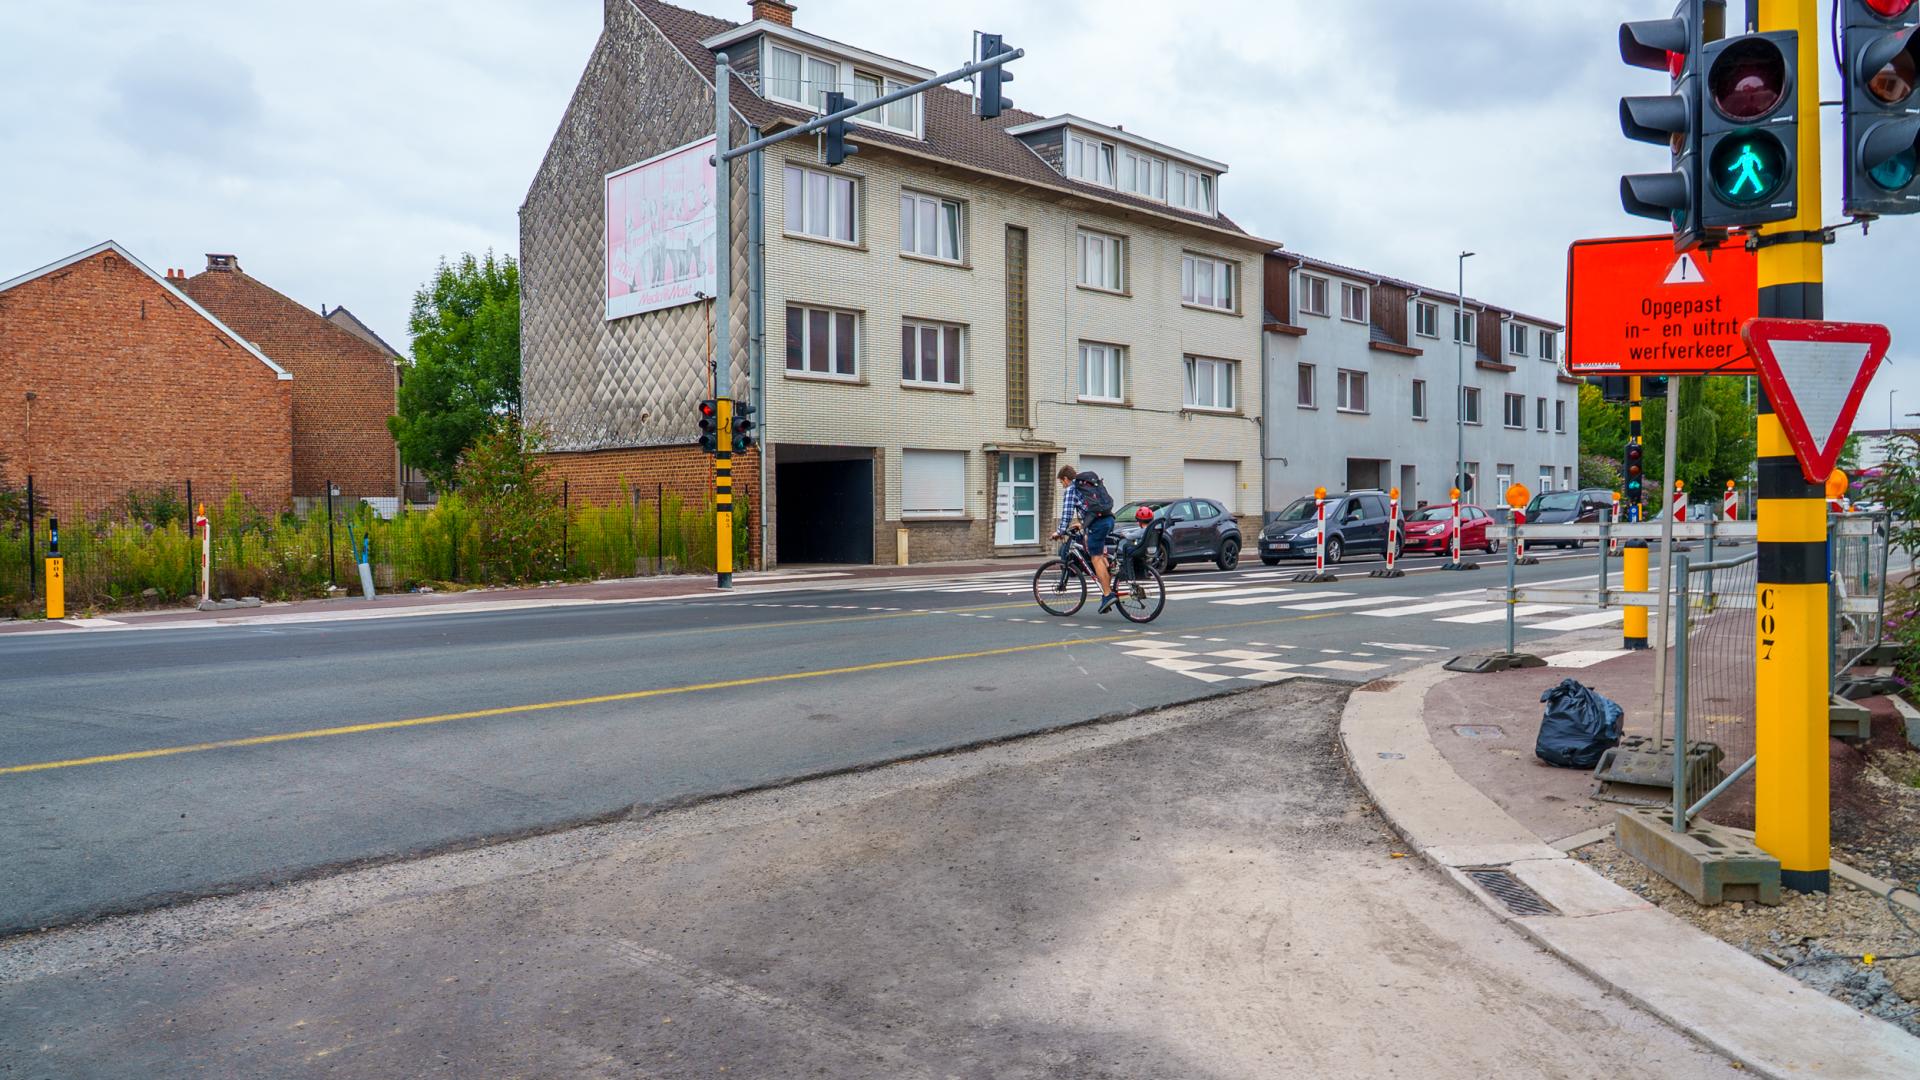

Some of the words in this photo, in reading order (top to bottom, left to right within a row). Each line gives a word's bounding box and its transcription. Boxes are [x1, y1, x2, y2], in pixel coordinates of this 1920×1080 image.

[1641, 295, 1722, 319] Opgepast
[1625, 322, 1649, 338] in-
[1662, 323, 1682, 337] en
[1693, 317, 1738, 336] uitrit
[1629, 342, 1733, 360] werfverkeer
[1761, 588, 1775, 660] C07
